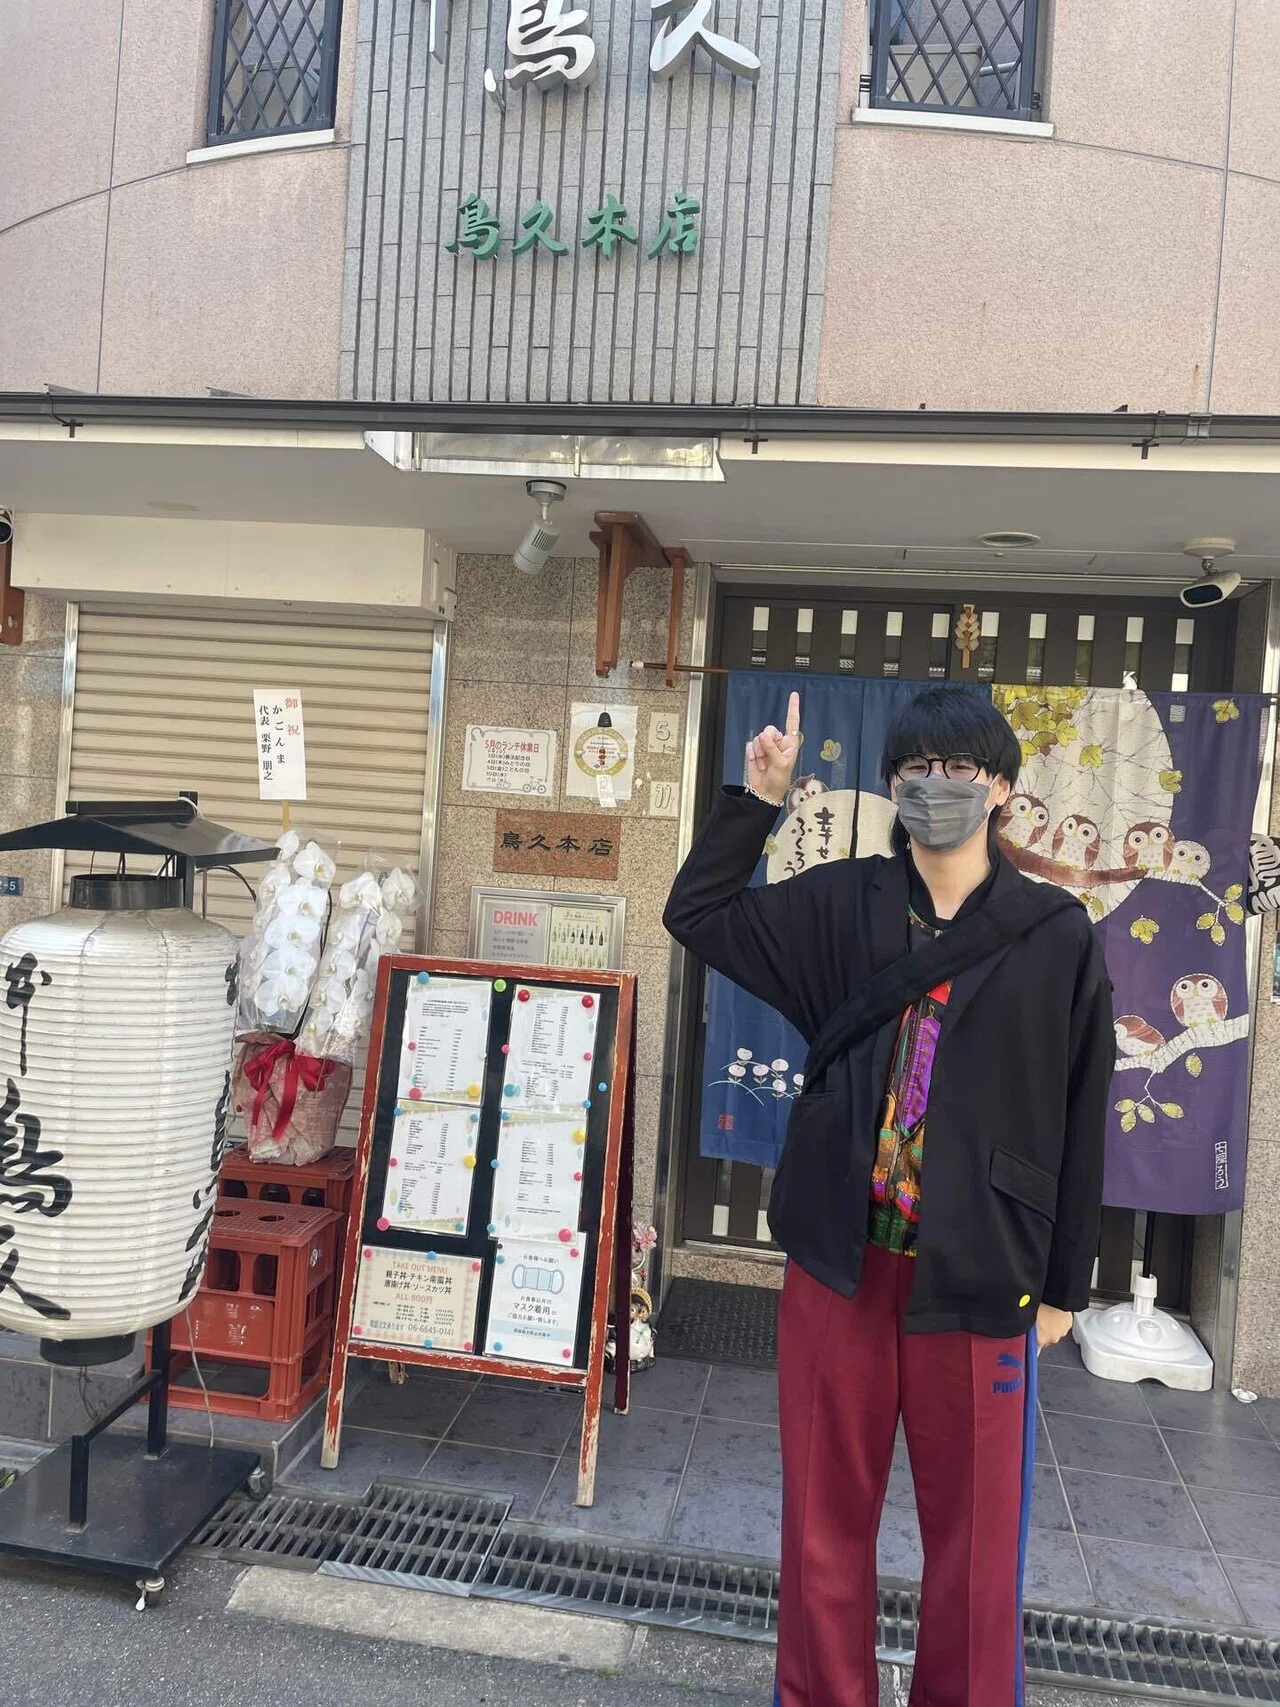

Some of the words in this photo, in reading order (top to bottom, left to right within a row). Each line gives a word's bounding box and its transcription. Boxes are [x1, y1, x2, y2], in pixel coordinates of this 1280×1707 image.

[445, 192, 701, 260] 鳥久本店
[260, 705, 270, 726] 代表
[500, 830, 613, 856] 鳥久本店
[814, 806, 835, 860] 幸せ
[493, 909, 539, 927] DRINK
[392, 1261, 409, 1270] TAKE
[411, 1263, 425, 1272] OUT
[427, 1265, 448, 1274] MENU
[395, 1292, 410, 1301] ALL
